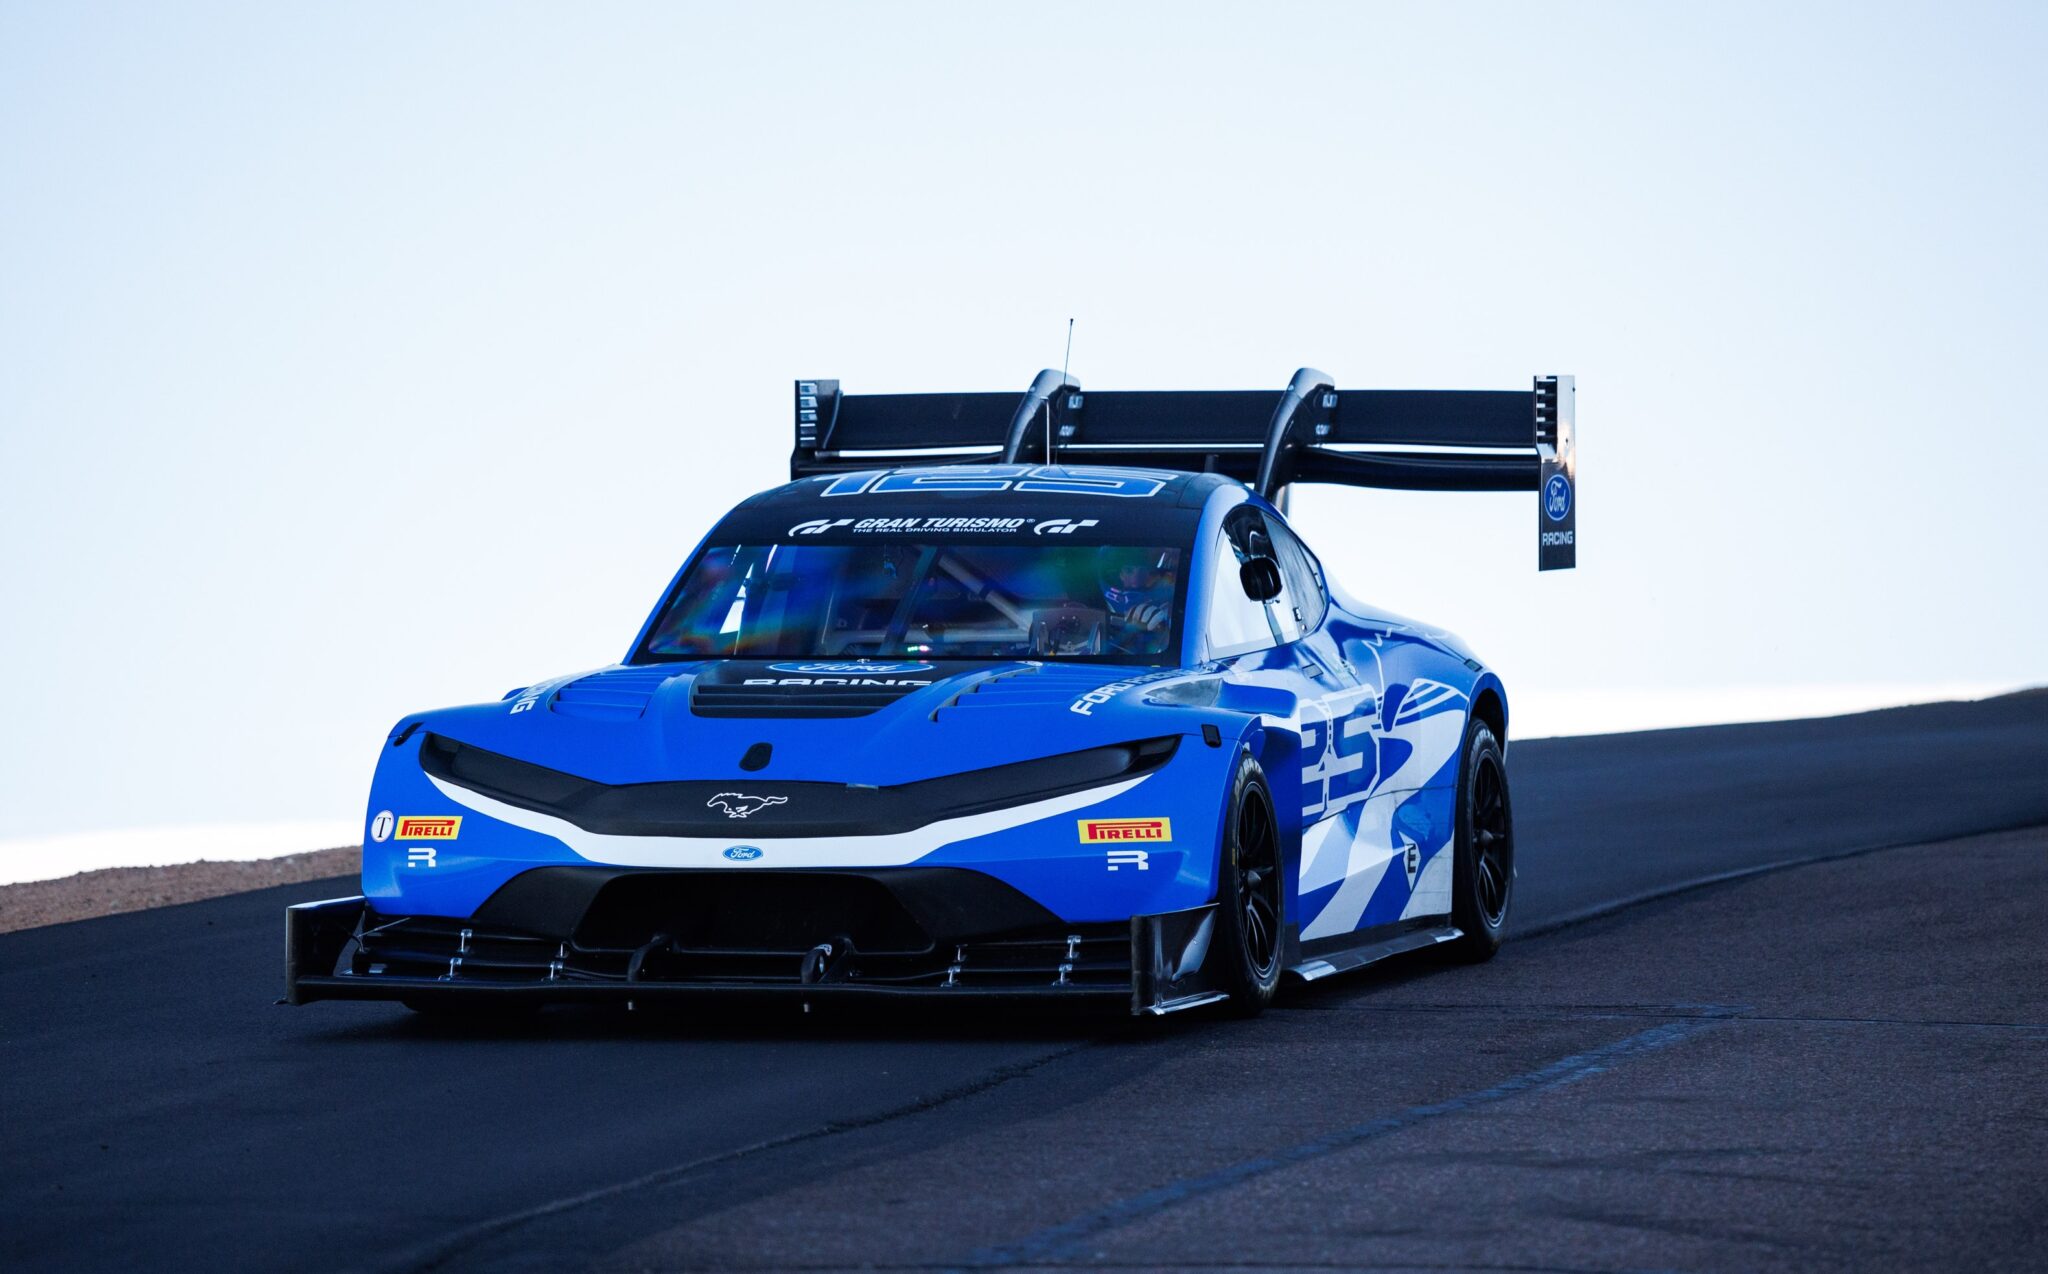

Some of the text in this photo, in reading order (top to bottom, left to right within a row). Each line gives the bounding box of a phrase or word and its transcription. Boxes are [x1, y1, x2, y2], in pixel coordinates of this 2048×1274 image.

[814, 464, 1178, 497] 125
[1549, 480, 1567, 512] Ford
[854, 518, 922, 528] GRAN
[1542, 531, 1573, 546] RACING
[1069, 682, 1136, 716] FORD
[401, 819, 456, 837] PIRELLI
[1087, 821, 1163, 840] PIRELLI
[730, 847, 756, 859] Ford
